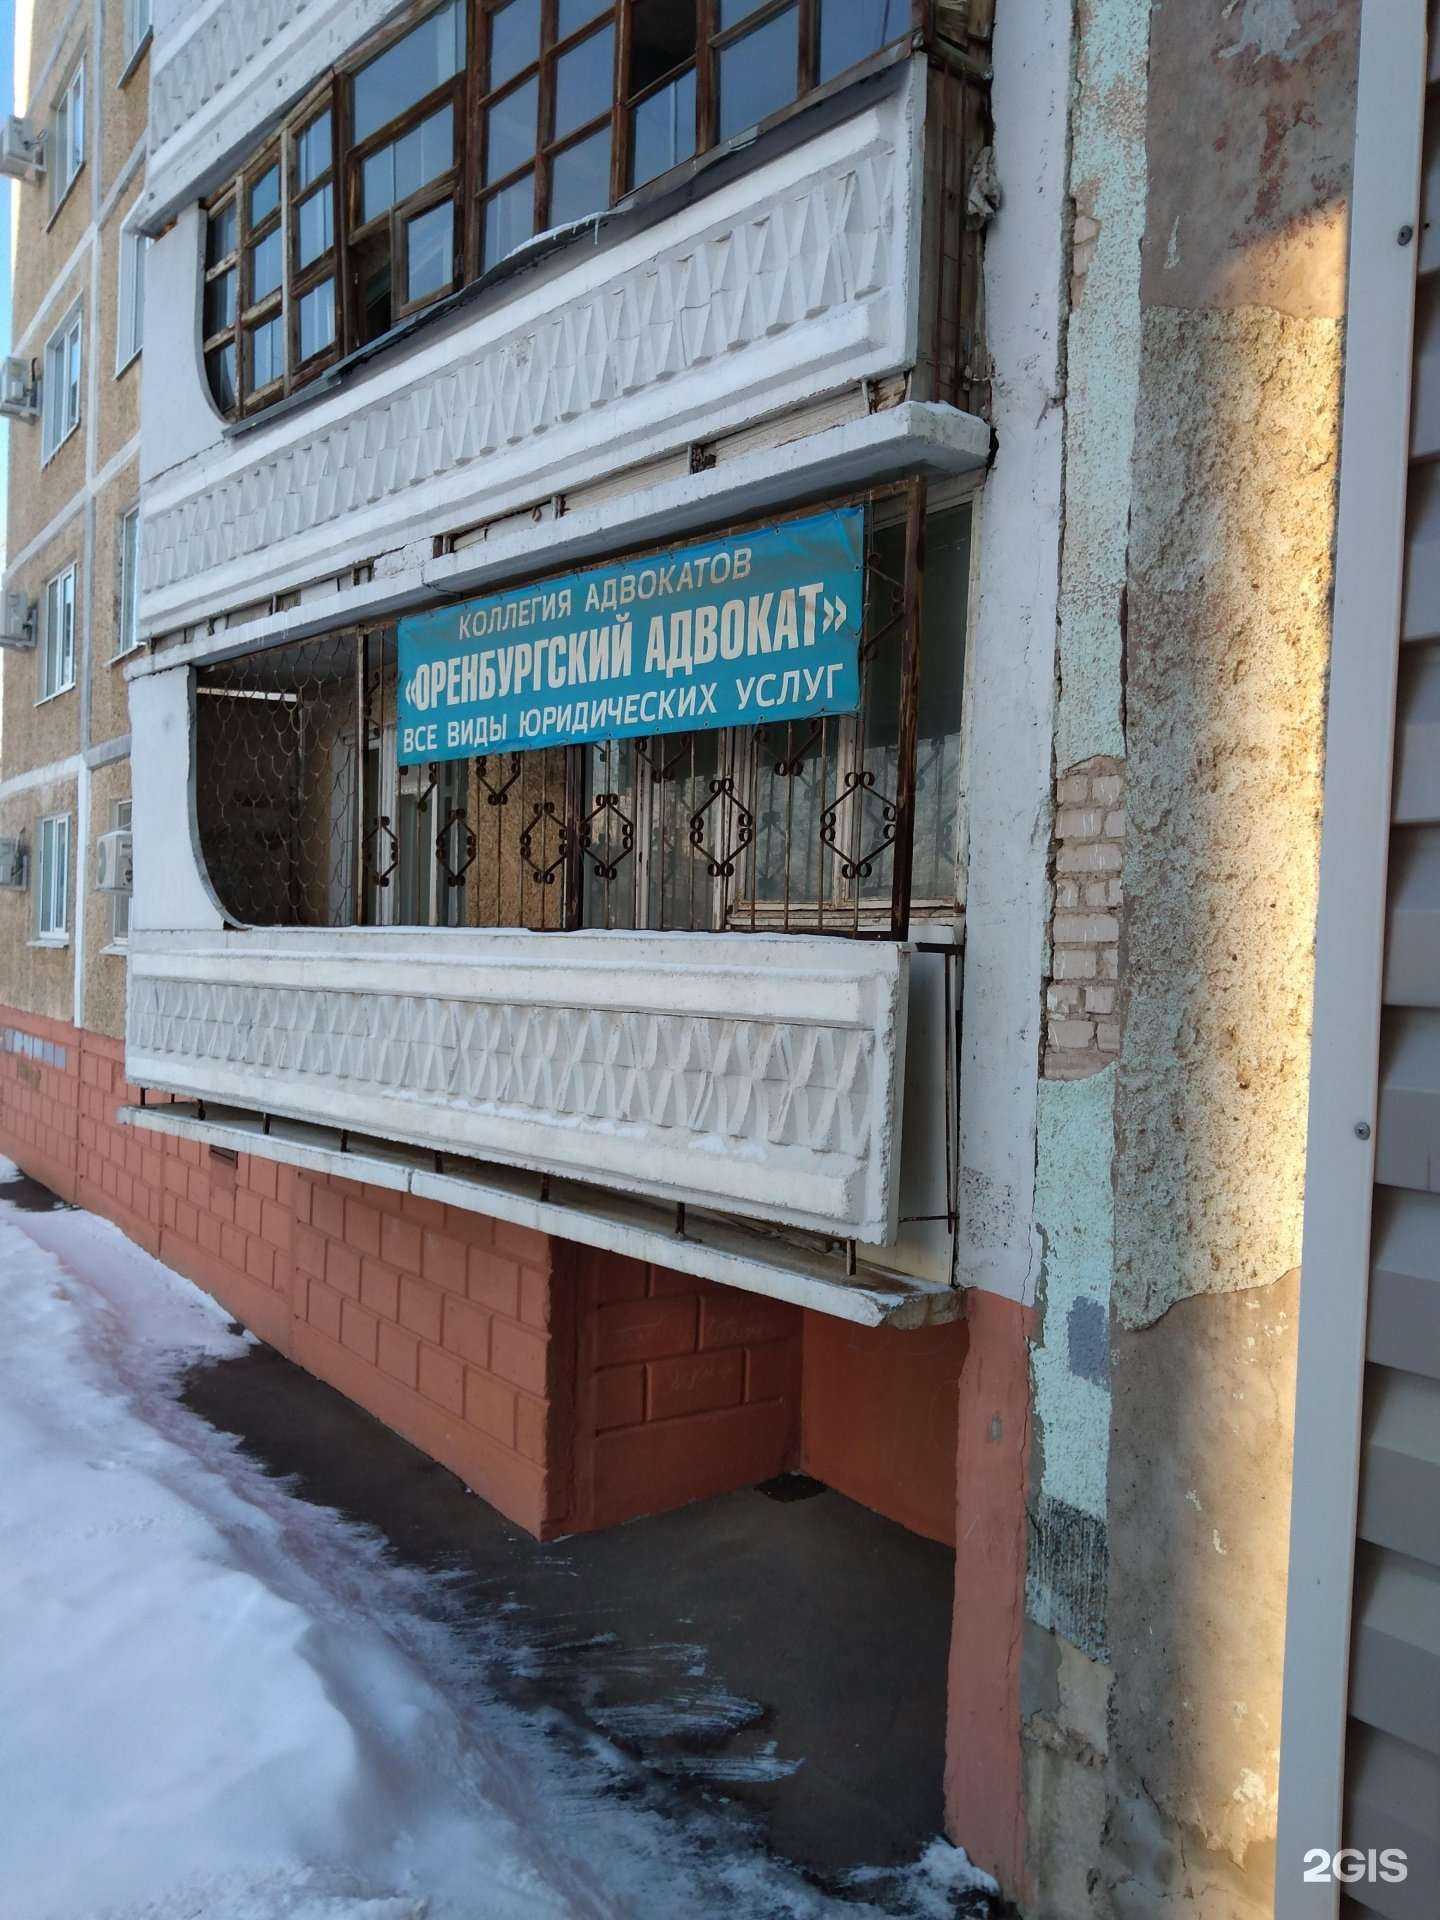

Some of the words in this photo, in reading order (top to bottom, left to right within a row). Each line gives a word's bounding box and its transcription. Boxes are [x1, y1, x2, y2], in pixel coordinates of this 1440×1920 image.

[459, 588, 572, 640] КОЛЛЕГИЯ
[585, 548, 752, 613] АДВОКАТОВ
[405, 612, 633, 711] «ОРЕНБУРГСКИЙ
[644, 582, 847, 679] АДВОКАТ»
[403, 724, 438, 753] ВСЕ
[447, 713, 507, 747] ВИДЫ
[519, 682, 717, 738] ЮРИДИЧЕСКИХ
[736, 663, 843, 710] УСЛУГ
